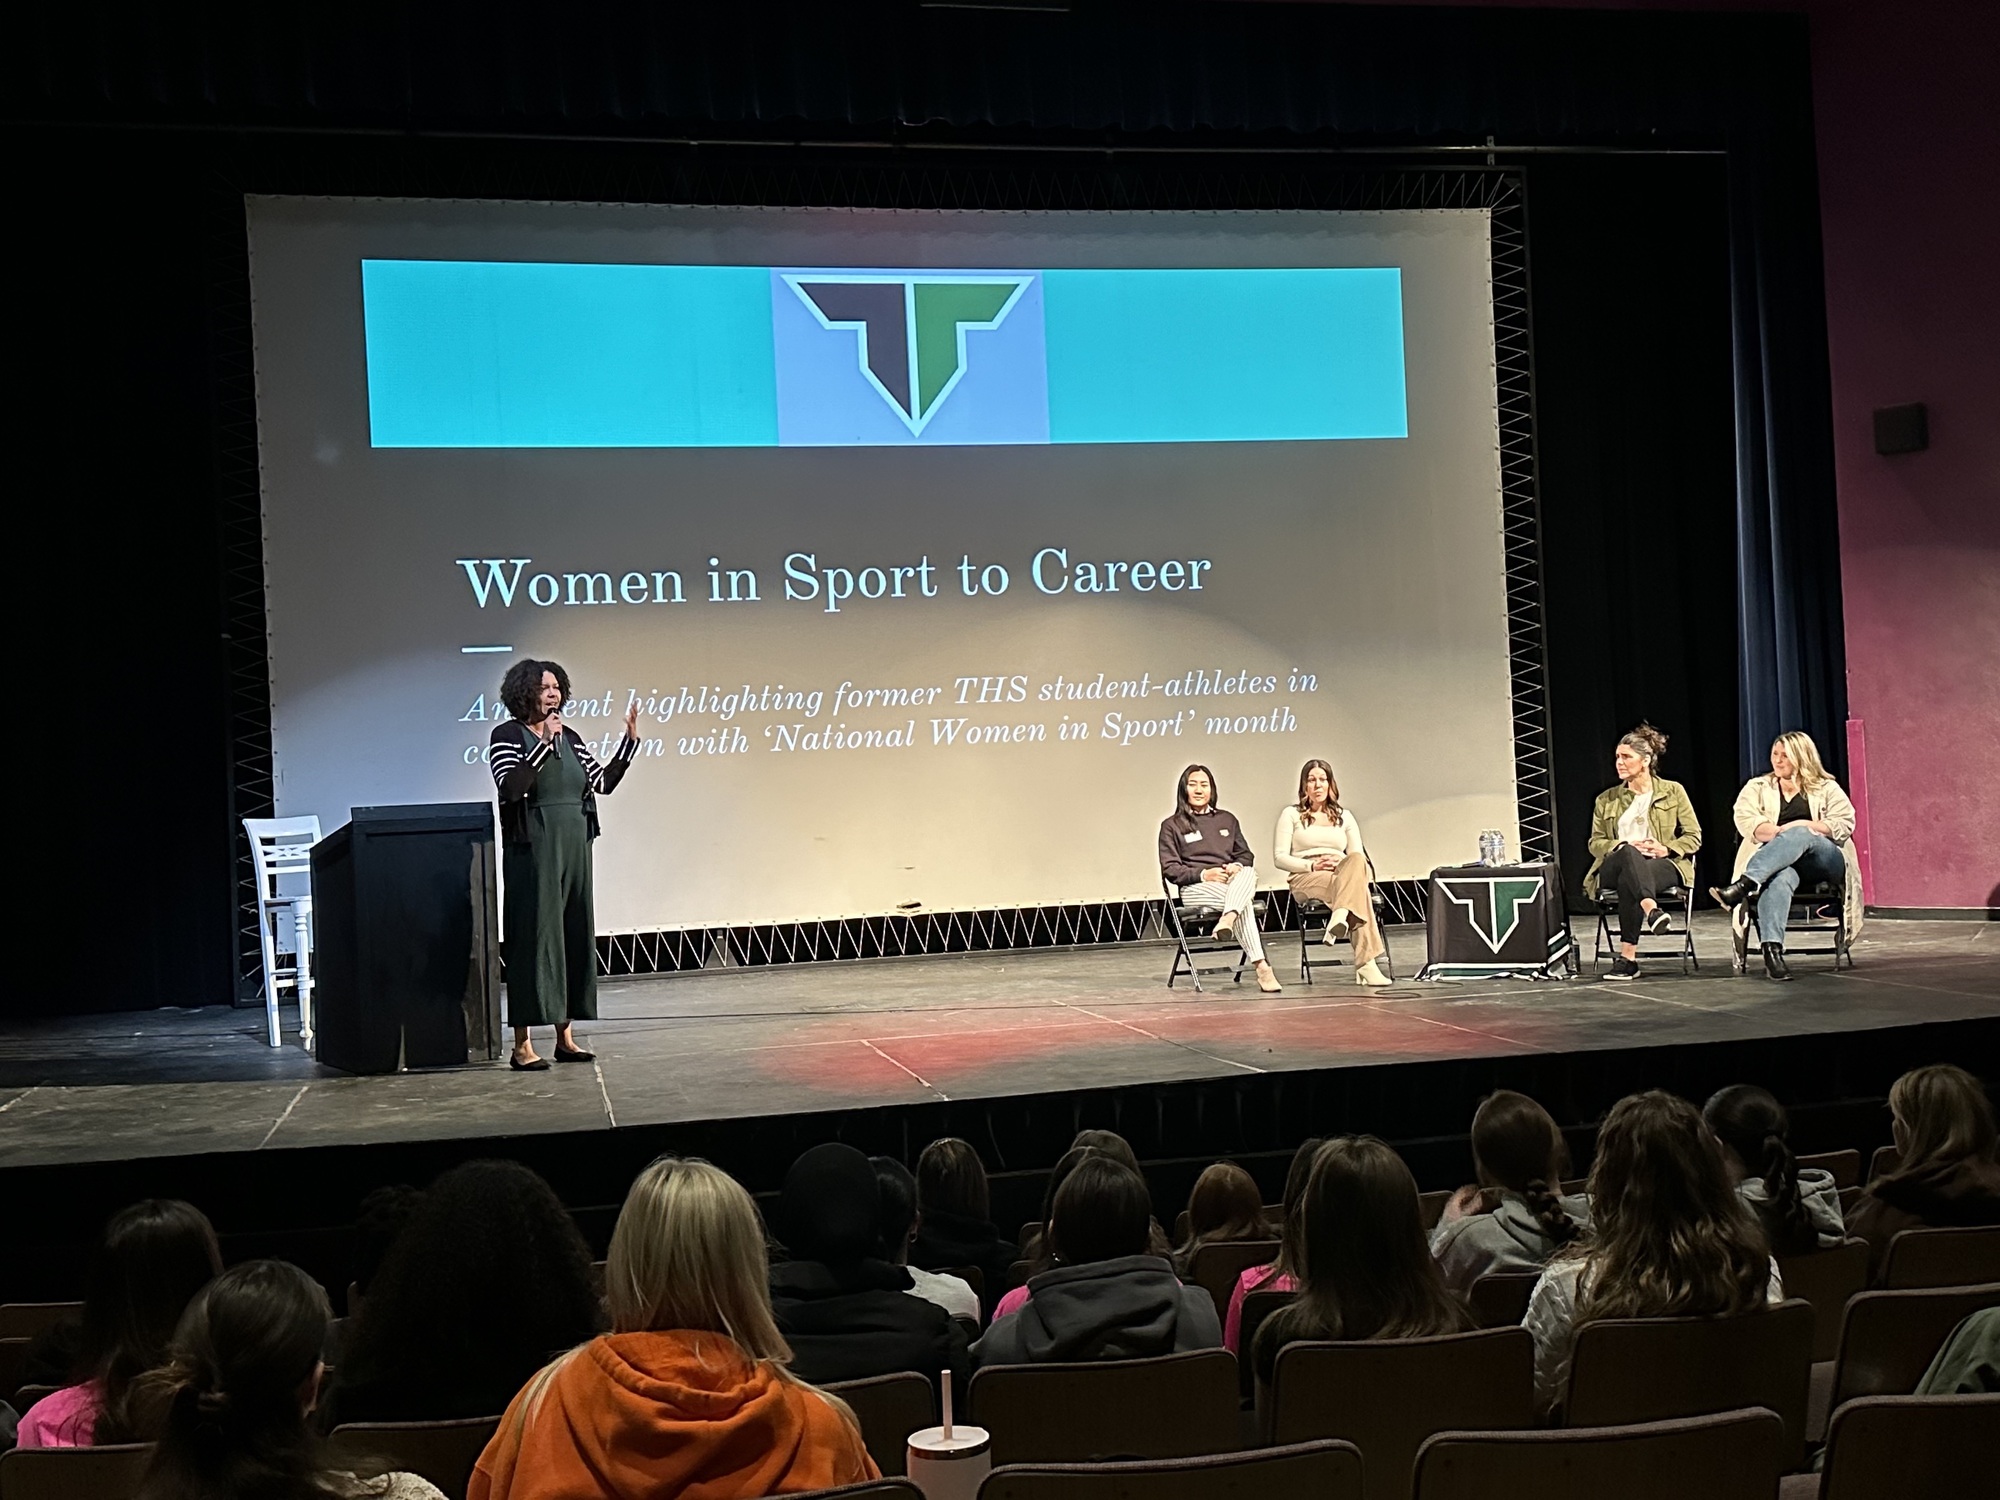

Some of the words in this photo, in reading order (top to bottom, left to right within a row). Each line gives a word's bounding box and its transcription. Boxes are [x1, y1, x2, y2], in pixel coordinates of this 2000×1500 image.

[455, 558, 687, 608] Women
[707, 557, 761, 602] in
[784, 552, 938, 613] Sport
[957, 554, 1010, 596] to
[1031, 547, 1212, 595] Career
[624, 684, 824, 723] highlighting
[832, 681, 943, 717] former
[953, 675, 1028, 704] THS
[1037, 668, 1278, 702] student-athletes
[1287, 667, 1319, 693] in
[677, 726, 750, 756] with
[764, 720, 916, 752] ‘National
[930, 717, 1047, 746] Women
[1058, 715, 1090, 741] in
[1100, 709, 1196, 746] Sport’
[1204, 706, 1298, 735] month
